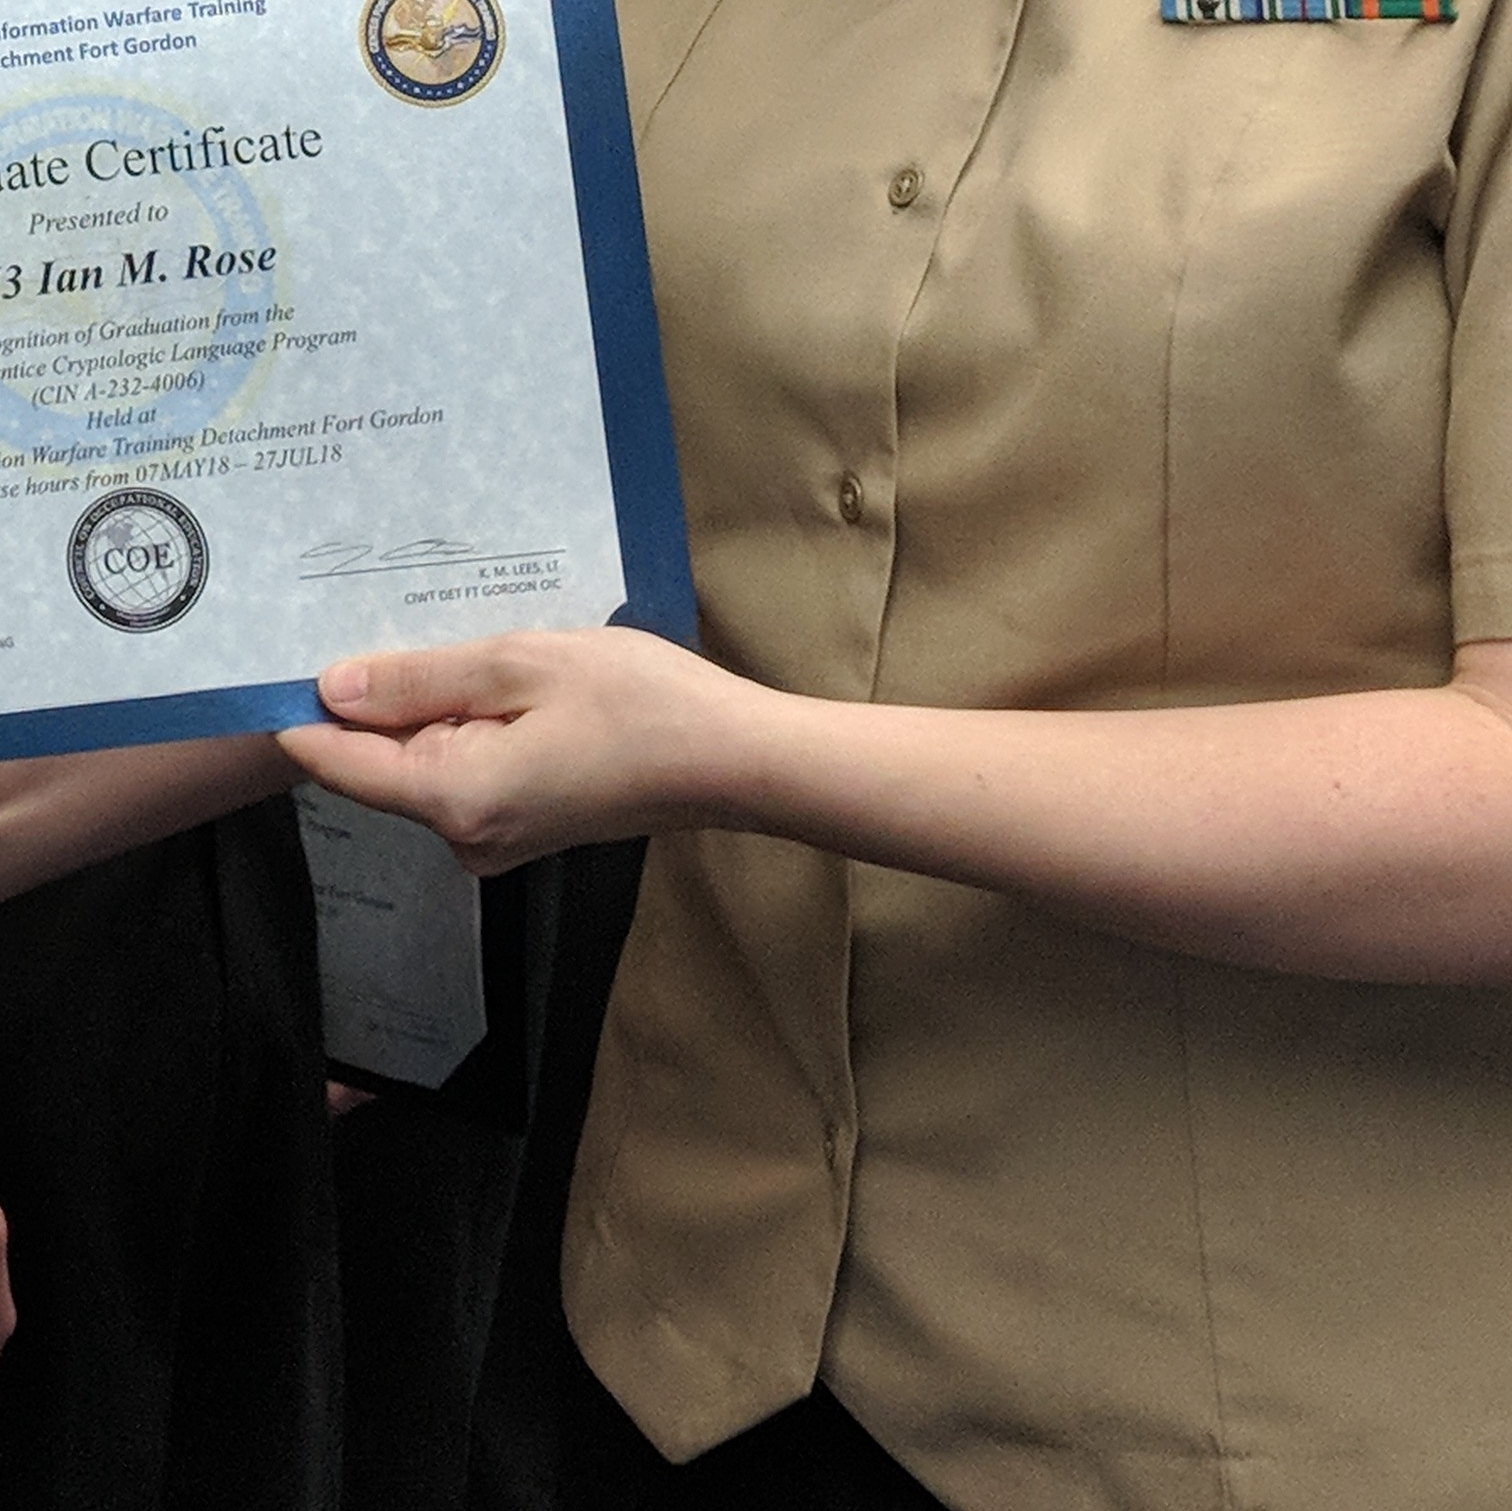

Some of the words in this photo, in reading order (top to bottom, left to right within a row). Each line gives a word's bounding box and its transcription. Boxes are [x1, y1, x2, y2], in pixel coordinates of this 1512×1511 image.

[103, 4, 182, 30] Warfare
[79, 42, 119, 61] Fort
[123, 32, 198, 56] Gordon
[86, 124, 325, 182] Certificate
[28, 201, 140, 235] Presented
[146, 203, 169, 224] to
[37, 260, 104, 297] Ian
[116, 249, 169, 288] M.
[184, 243, 278, 281] Rose
[74, 320, 98, 345] of
[98, 314, 210, 340] Graduation
[212, 307, 260, 334] from
[265, 303, 295, 323] the
[51, 346, 166, 378] Cryptologic
[170, 338, 267, 363] Language
[271, 328, 358, 354] Program
[31, 384, 80, 411] (CIN
[84, 369, 206, 402] A-232-4006)
[31, 441, 108, 467] Warfare
[112, 433, 194, 458] Training
[200, 422, 316, 449] Detachment
[322, 414, 364, 435] Fort
[369, 406, 445, 430] Gordon
[86, 406, 134, 431] Held
[137, 407, 157, 425] at
[25, 476, 80, 496] hours
[85, 469, 130, 494] from
[135, 455, 231, 484] 07MAY18
[253, 443, 344, 472] 27JUL18
[104, 543, 174, 575] COE
[482, 581, 537, 597] GORDON
